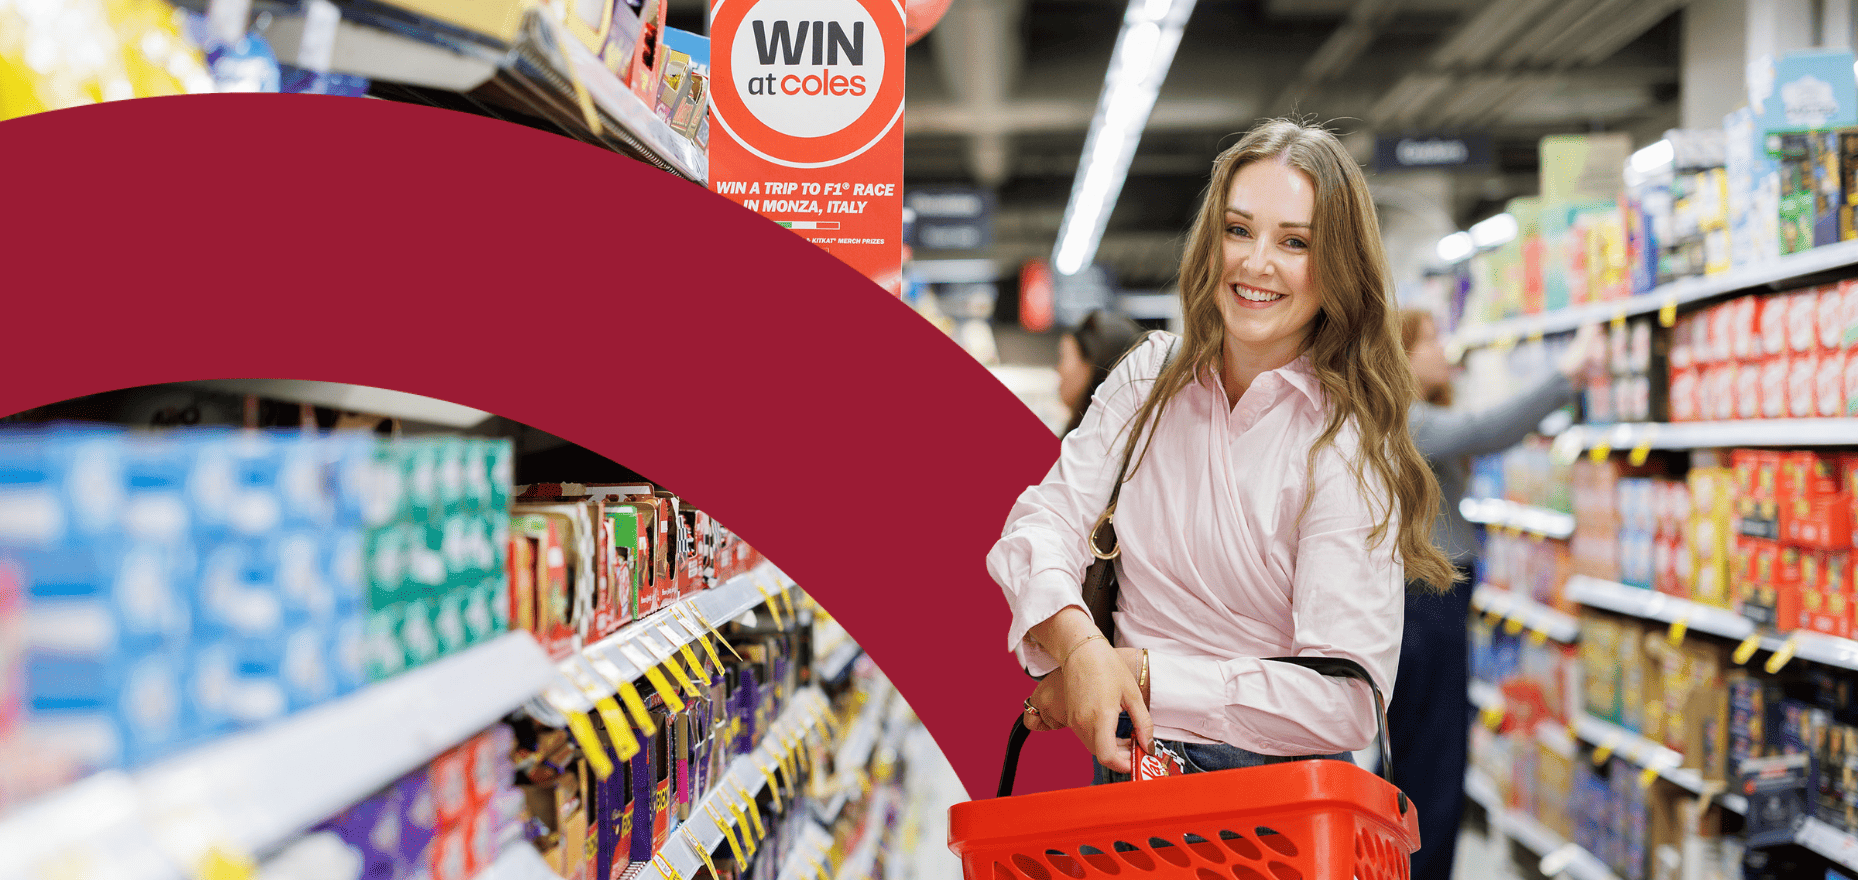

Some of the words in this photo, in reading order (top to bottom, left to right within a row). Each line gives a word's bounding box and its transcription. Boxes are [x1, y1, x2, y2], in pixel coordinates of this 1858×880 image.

[752, 20, 864, 66] WIN
[748, 73, 776, 95] at
[781, 69, 866, 96] coles
[716, 181, 747, 194] WIN
[749, 182, 760, 195] A
[764, 182, 798, 195] TRIP
[801, 182, 821, 196] TO
[853, 183, 895, 196] RACE
[743, 199, 760, 212] IN
[762, 200, 823, 216] MONZA,
[827, 201, 868, 214] ITALY
